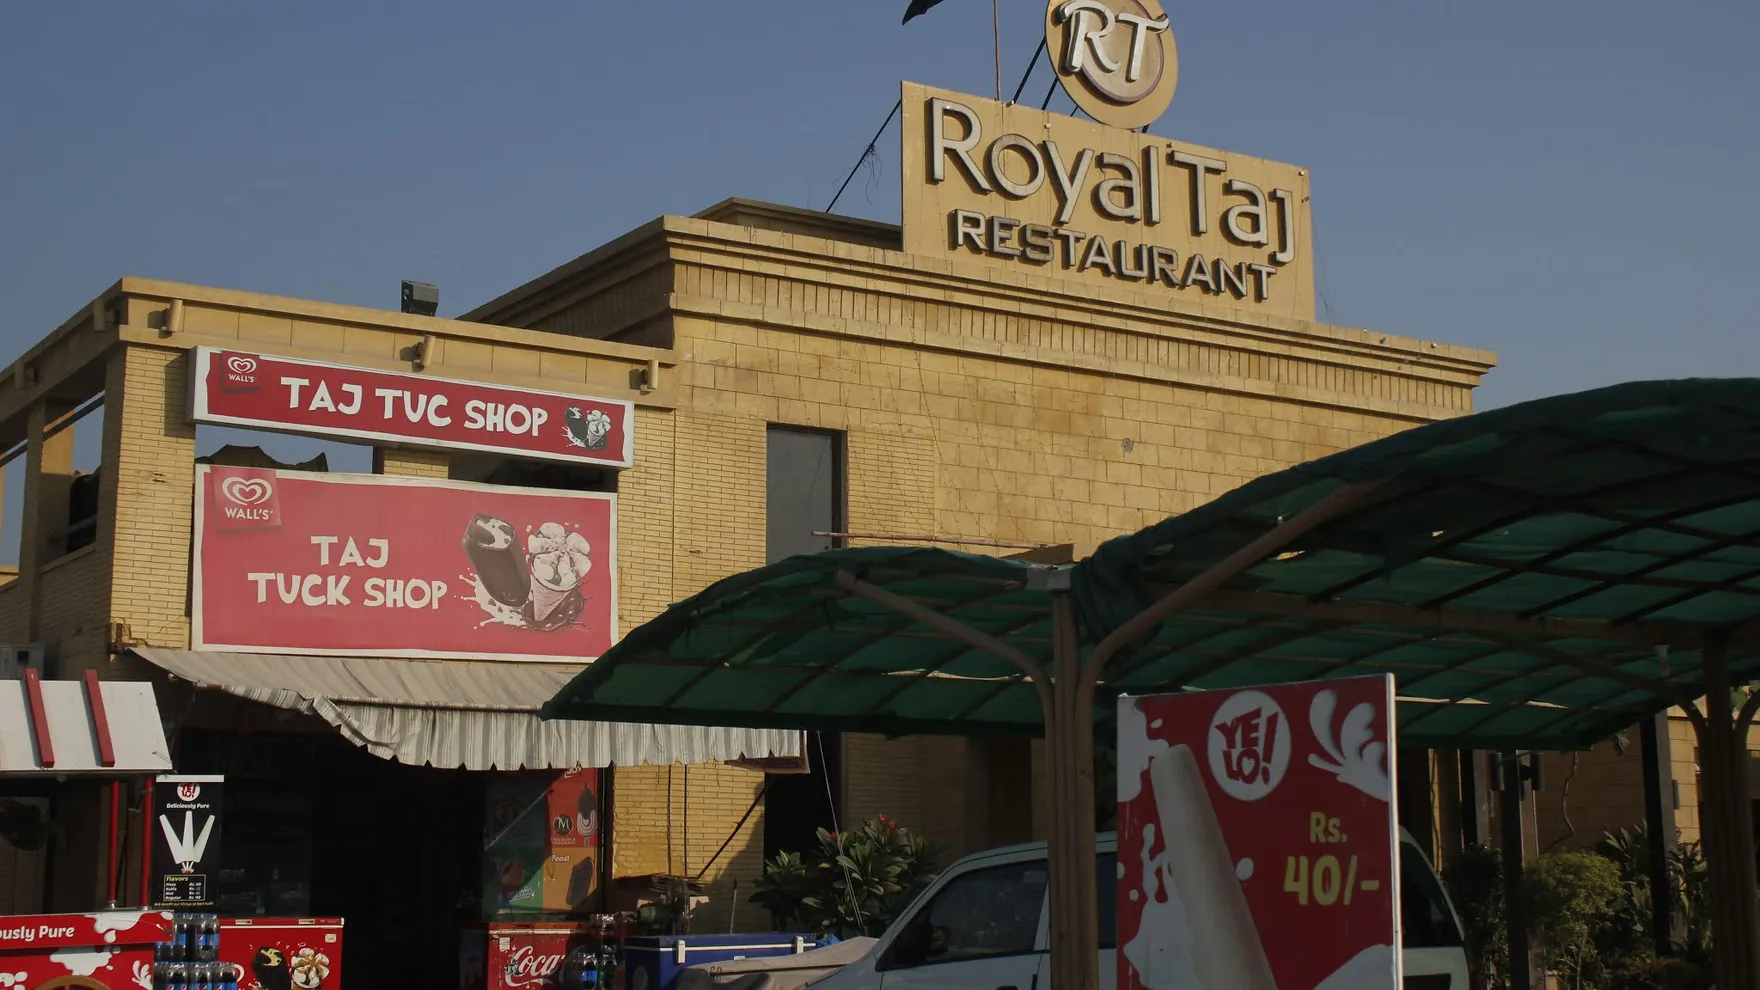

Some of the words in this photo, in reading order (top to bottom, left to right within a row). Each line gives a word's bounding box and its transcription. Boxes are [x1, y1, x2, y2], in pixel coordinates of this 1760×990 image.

[1059, 0, 1170, 82] RT
[930, 97, 1161, 225] Royal
[951, 208, 1277, 301] RESTAURANT
[228, 373, 255, 383] WALL'S
[280, 376, 363, 415] TAJ
[375, 388, 452, 425] TUC
[464, 400, 548, 437] SHOP
[225, 507, 269, 521] WALL'S
[310, 535, 389, 569] TAJ
[247, 572, 351, 606] TUCK
[364, 577, 448, 611] SHOP
[1310, 811, 1348, 843] Rs.
[1283, 855, 1380, 906] 40/-
[39, 925, 75, 939] Pure
